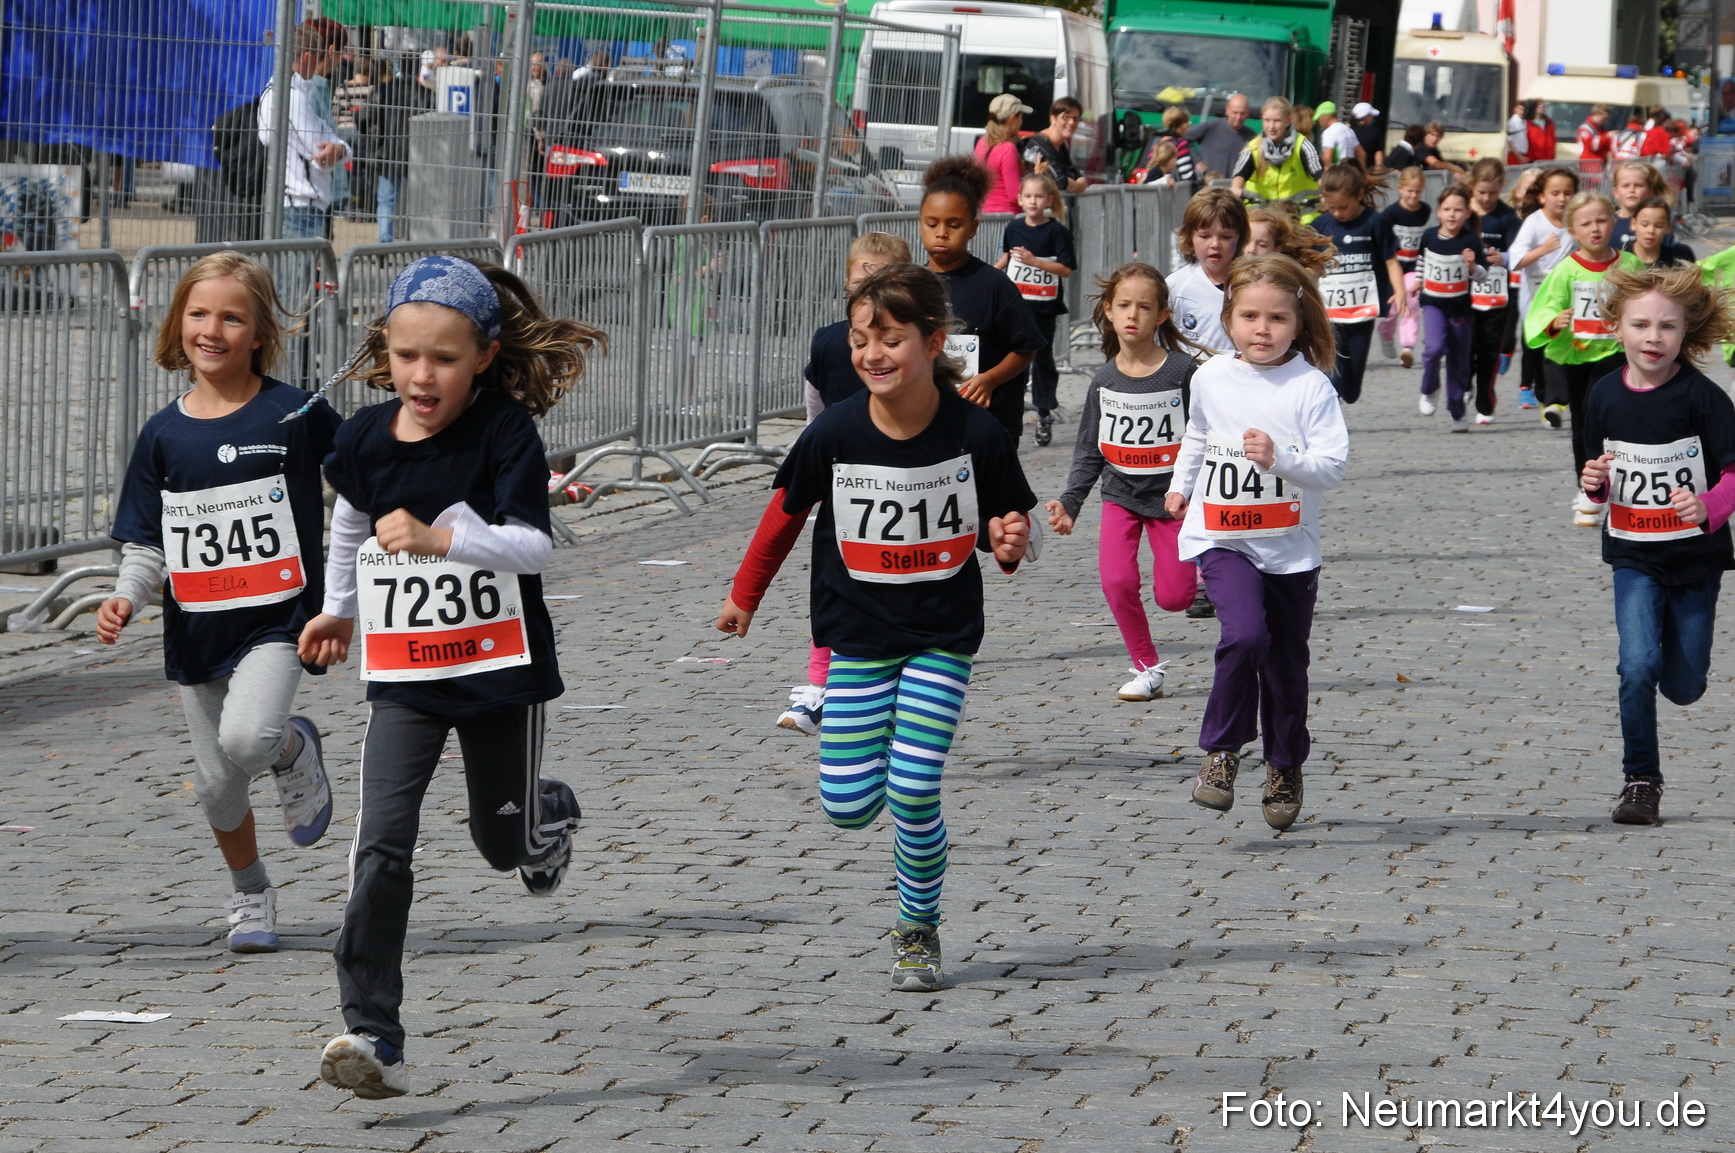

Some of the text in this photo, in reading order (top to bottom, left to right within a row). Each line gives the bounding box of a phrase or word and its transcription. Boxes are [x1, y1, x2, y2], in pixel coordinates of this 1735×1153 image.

[667, 176, 692, 189] 222
[1400, 234, 1419, 248] 724
[1014, 265, 1052, 284] 7256
[1428, 263, 1463, 281] 7314
[1326, 286, 1369, 307] 7317
[1122, 401, 1167, 411] Neumarkt
[1105, 413, 1175, 445] 7224
[1118, 450, 1161, 464] Leonie
[1206, 444, 1223, 456] RTL
[1633, 453, 1685, 465] Neumarkt
[836, 474, 952, 492] PARTL Neumarkt
[1205, 460, 1284, 500] 7041
[1616, 466, 1696, 506] 7258
[196, 493, 264, 516] Neumarkt
[850, 492, 963, 541] 7214
[1220, 510, 1262, 529] Katja
[170, 512, 281, 569] 7345
[360, 552, 404, 566] PARTL
[881, 550, 937, 569] Stella
[208, 576, 249, 593] Ella
[373, 570, 501, 628] 7236
[407, 639, 478, 663] Emma
